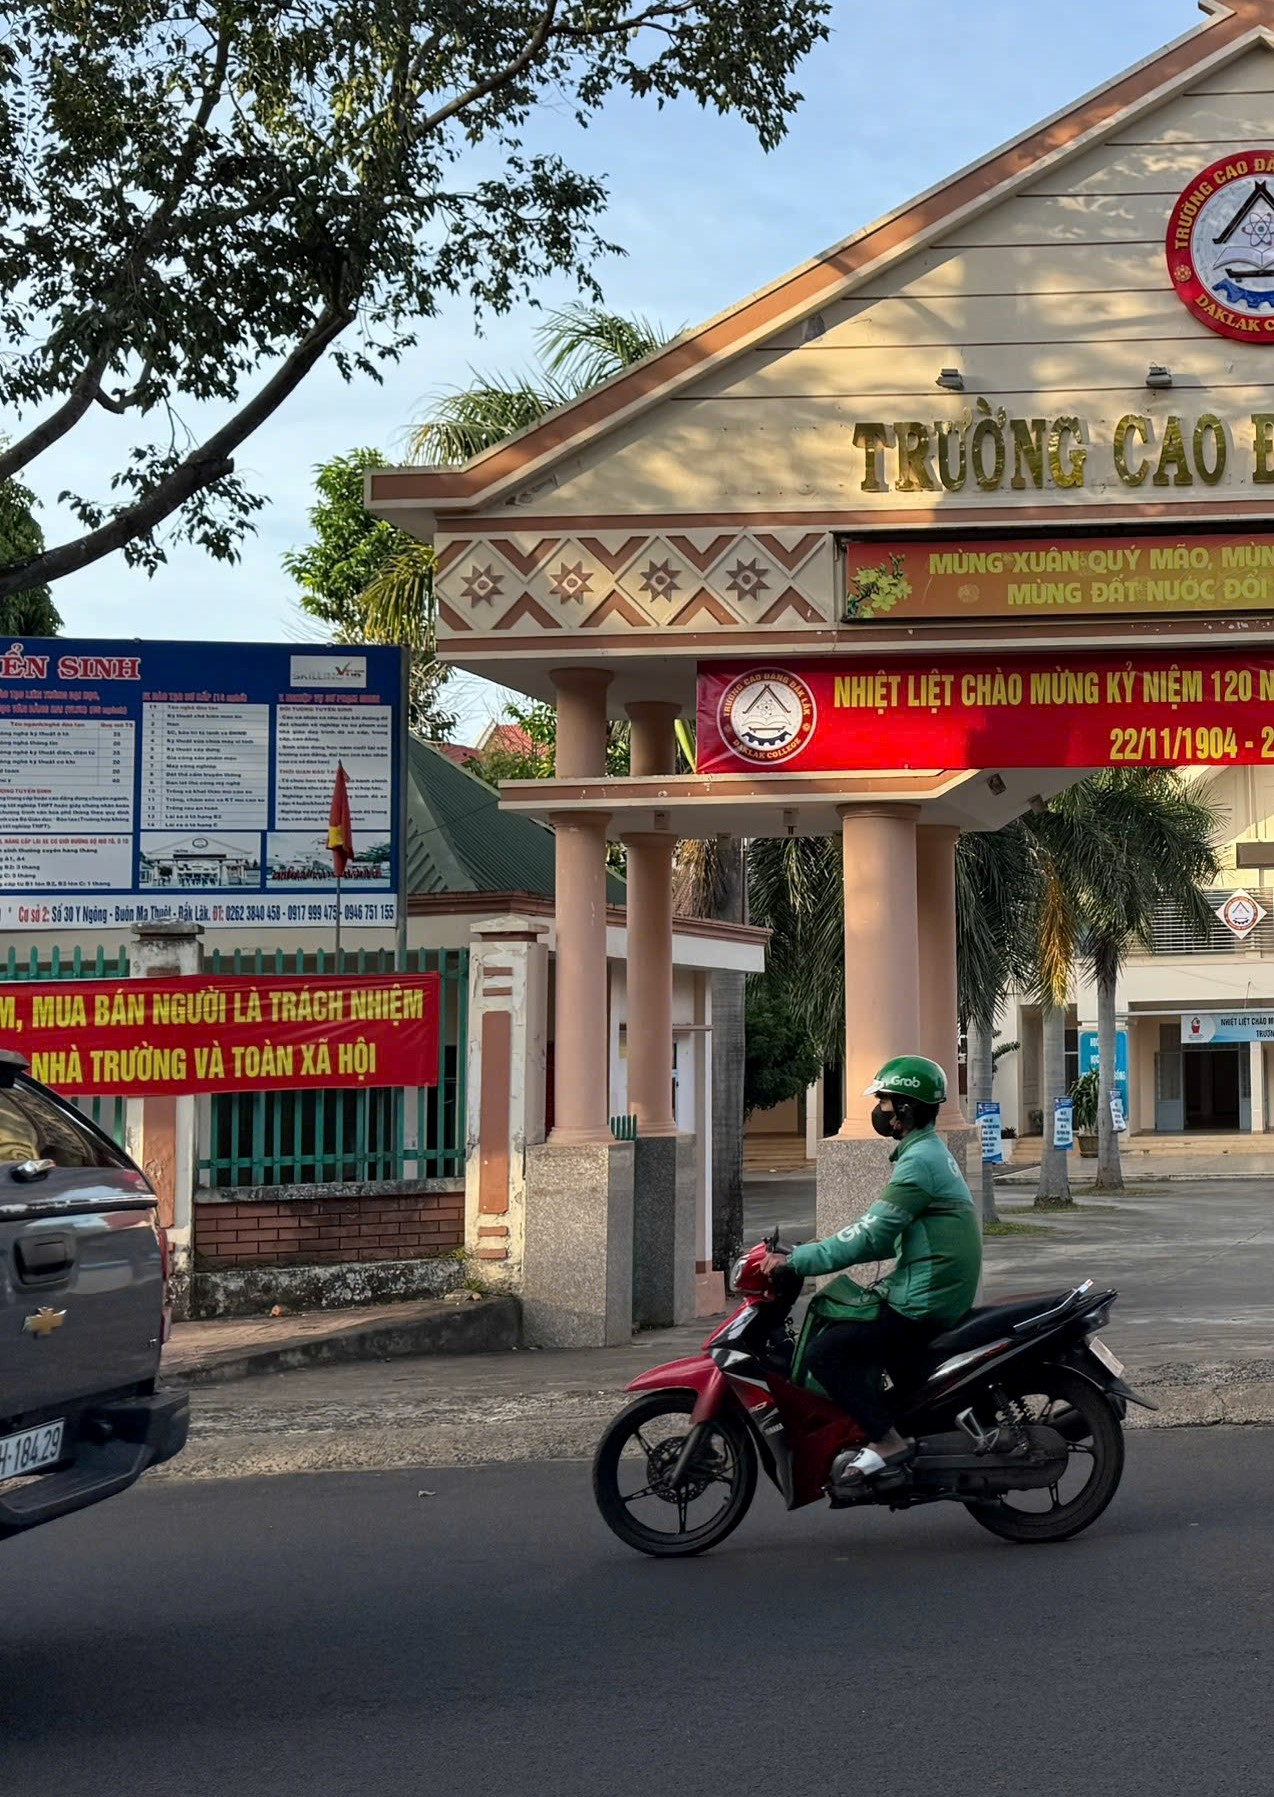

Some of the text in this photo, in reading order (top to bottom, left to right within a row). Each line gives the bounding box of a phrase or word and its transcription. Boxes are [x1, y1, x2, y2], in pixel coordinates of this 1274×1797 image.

[1175, 181, 1214, 249] TRƯỜNG
[1213, 160, 1249, 184] CAO
[1195, 294, 1260, 332] DAKLAK
[852, 396, 1087, 492] TRƯỜNG
[1113, 413, 1227, 486] CAO
[929, 548, 1003, 574] MỪNG
[1012, 546, 1080, 574] XUÂN
[1088, 544, 1141, 575] QUÝ
[1150, 543, 1212, 571] MÃO,
[1007, 579, 1082, 605] MỪNG
[1091, 574, 1139, 604] ĐẤT
[1147, 576, 1214, 602] NƯỚC
[1224, 570, 1267, 599] ĐỔI
[0, 642, 141, 679] ỂN SINH
[743, 674, 762, 686] CAO
[833, 669, 900, 714] NHIỆT
[907, 669, 955, 714] LIỆT
[960, 667, 1023, 706] CHÀO
[1029, 665, 1099, 706] MỪNG
[1106, 660, 1135, 703] KỶ
[1143, 664, 1203, 710] NIỆM
[1210, 670, 1253, 702] 120
[733, 738, 802, 759] DAKLAK COLLEGE
[1109, 726, 1237, 760] 22/11/1904
[52, 903, 62, 922] Số
[64, 906, 73, 922] 30
[76, 906, 81, 921] Y
[136, 905, 148, 921] Ma
[226, 905, 244, 921] 0262
[267, 905, 280, 921] 458
[288, 904, 306, 921] 0917
[308, 904, 322, 921] 999
[324, 904, 337, 920] 475
[345, 904, 362, 920] 0946
[365, 904, 378, 920] 751
[381, 904, 394, 920] 155
[32, 996, 86, 1028] MUA
[94, 987, 145, 1026] BÁN
[153, 985, 226, 1025] NGƯỜI
[234, 985, 262, 1023] LÀ
[268, 985, 343, 1022] TRÁCH
[350, 984, 424, 1026] NHIỆM
[31, 1036, 377, 1084] NHÀ TRƯỜNG VÀ TOÀN XÃ HỘI
[892, 1075, 921, 1088] Grab
